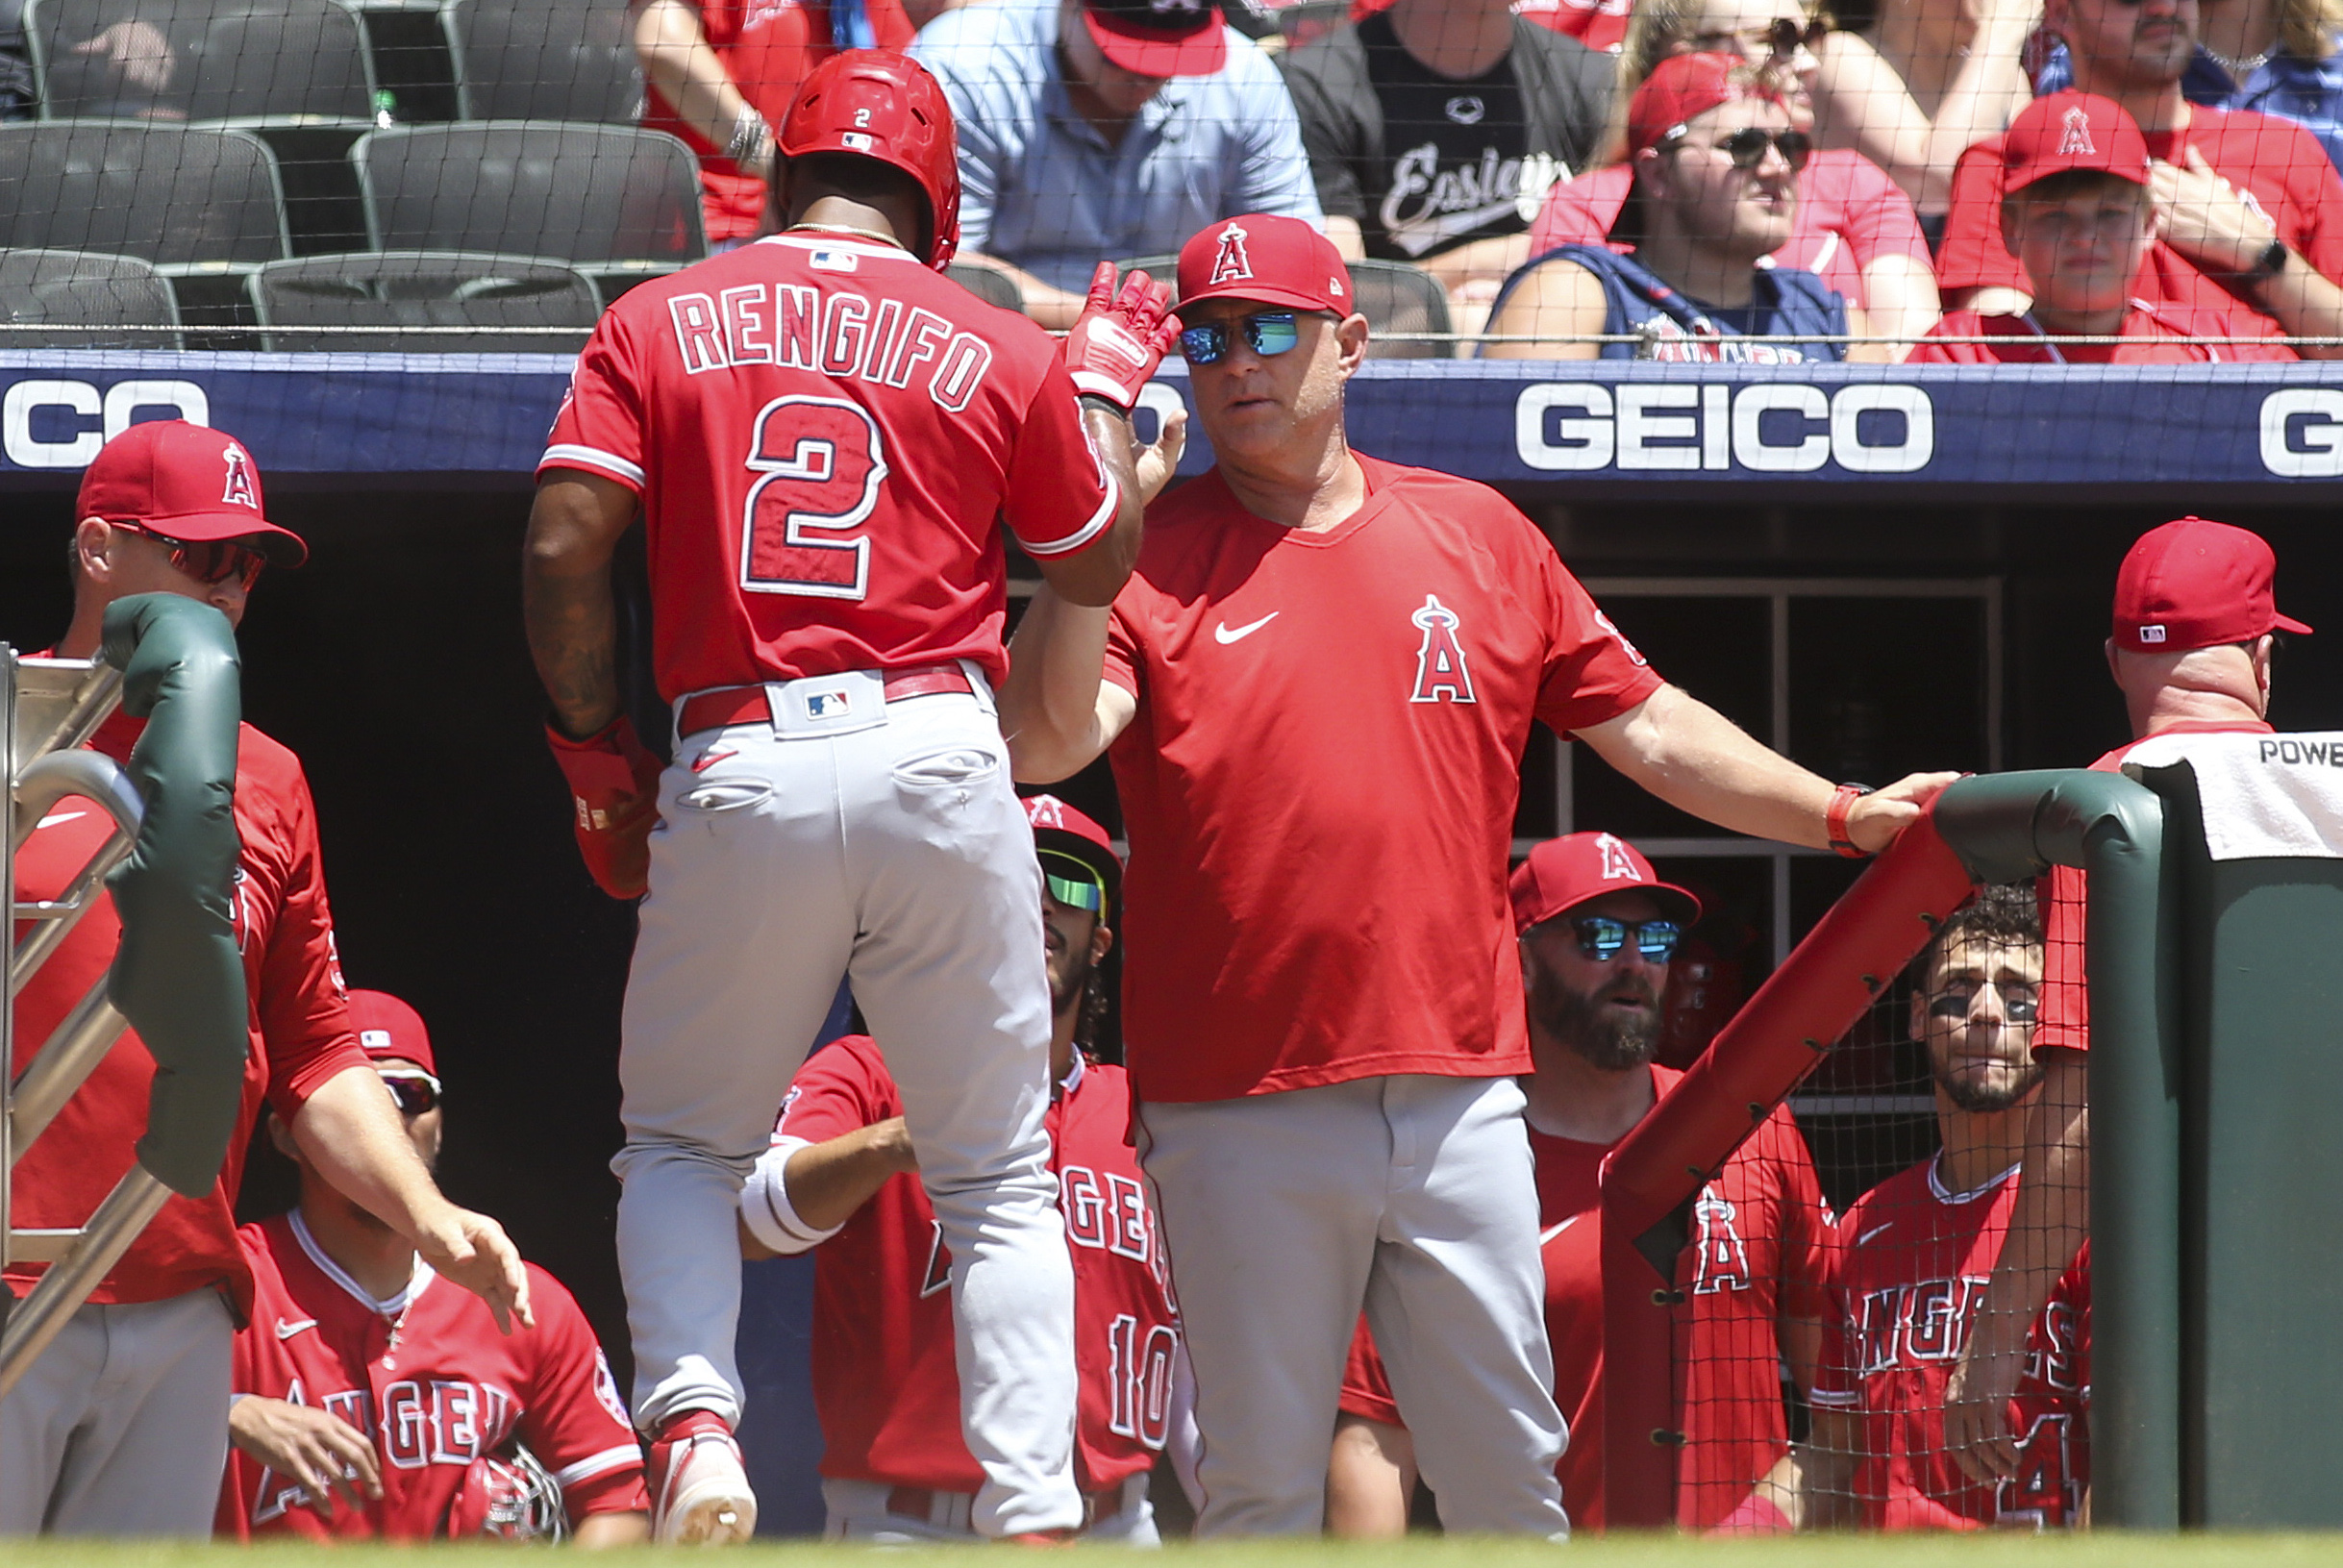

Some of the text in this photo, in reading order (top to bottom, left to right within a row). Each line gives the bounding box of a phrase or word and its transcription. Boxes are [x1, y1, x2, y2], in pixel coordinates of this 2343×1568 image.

[853, 107, 872, 129] 2
[1209, 222, 1255, 286] A
[667, 283, 993, 413] RENGIFO
[221, 441, 259, 510] A
[1515, 384, 1934, 472] GEICO
[740, 394, 890, 601] 2
[1408, 594, 1477, 704] A
[1594, 832, 1643, 883] A
[1693, 1183, 1752, 1295] A
[1109, 1313, 1178, 1451] 10
